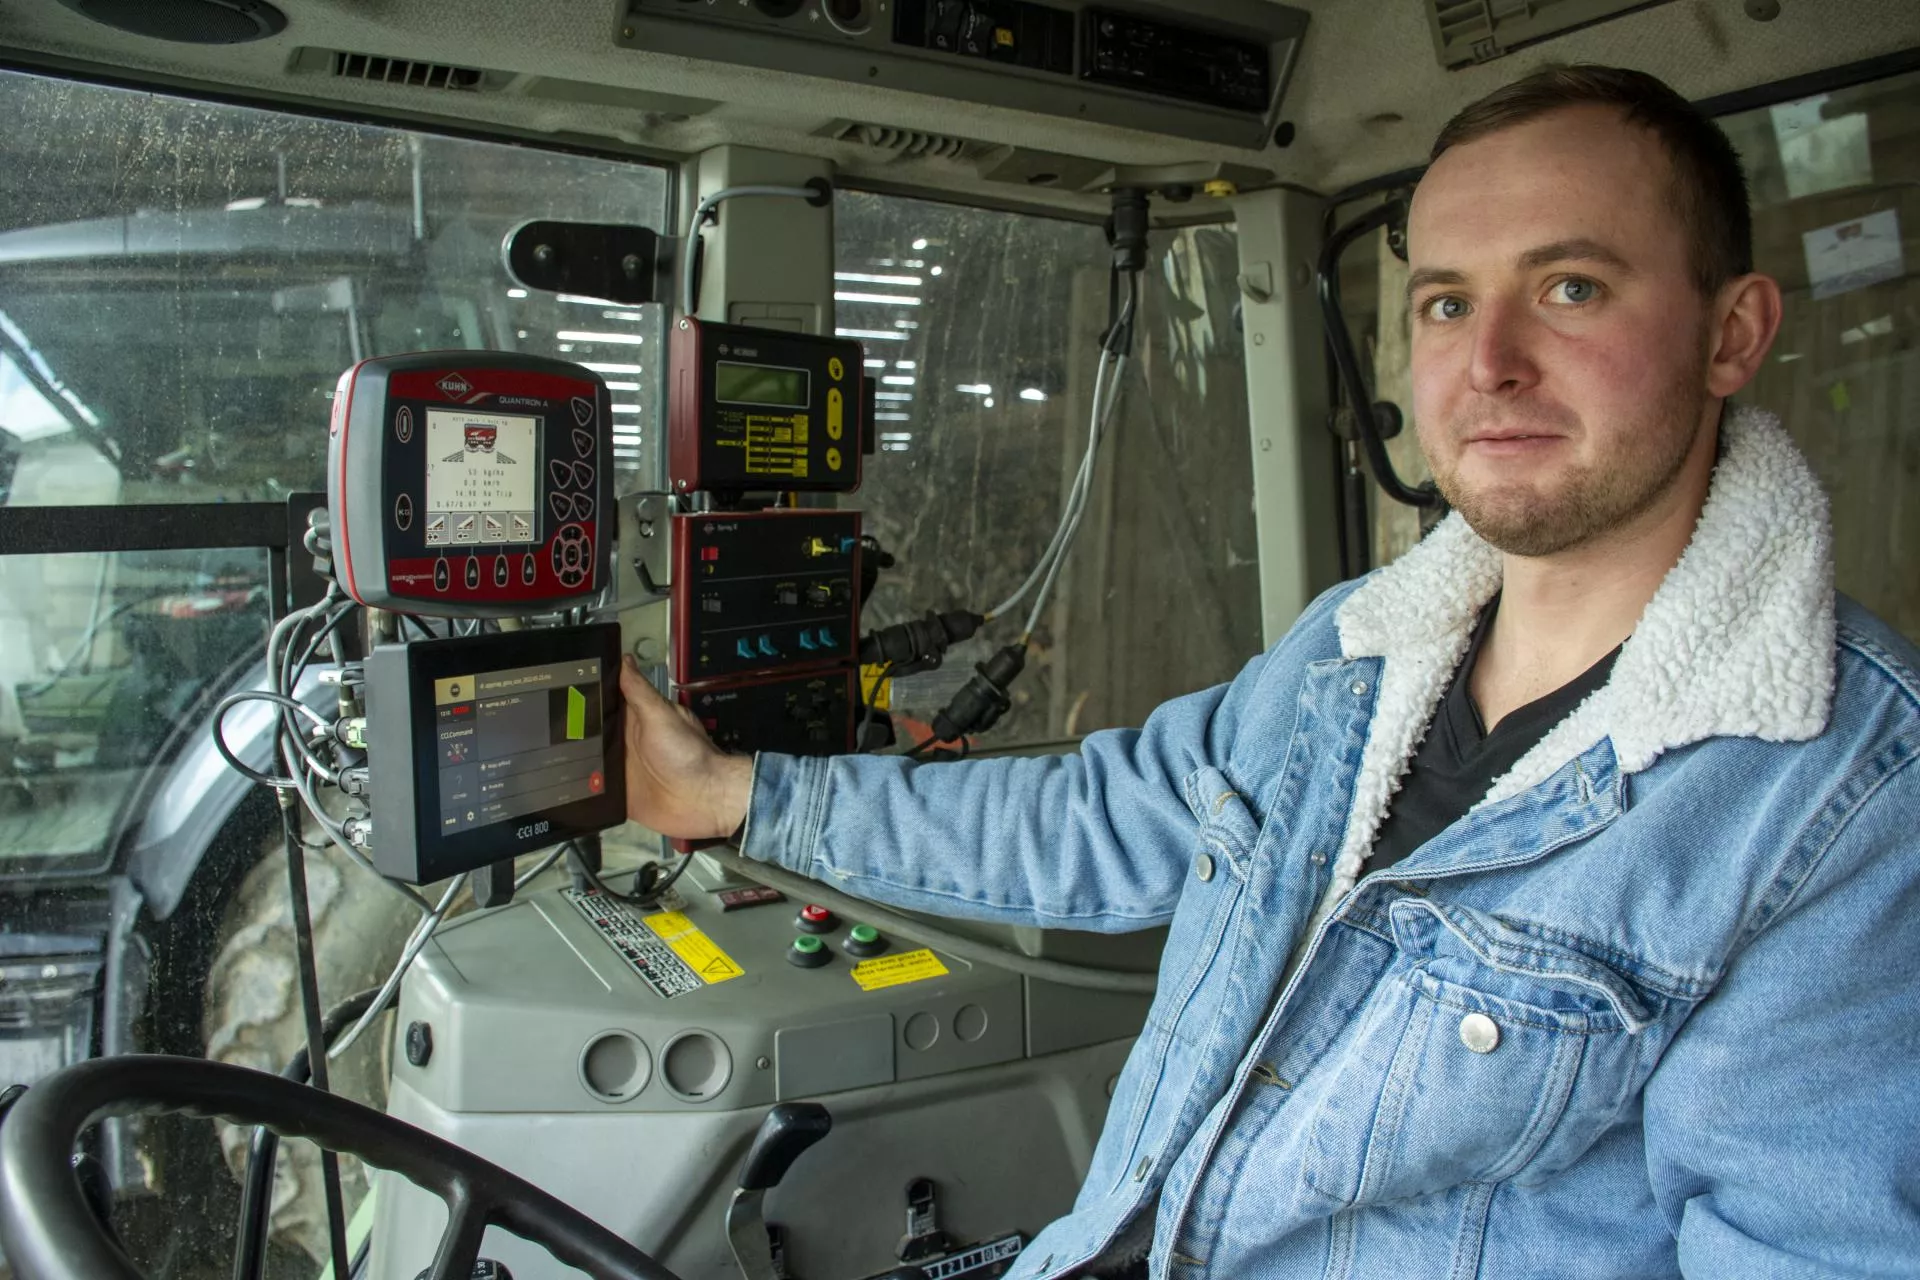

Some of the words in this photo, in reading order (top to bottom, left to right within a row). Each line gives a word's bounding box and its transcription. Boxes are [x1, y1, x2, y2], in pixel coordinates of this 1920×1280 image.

[441, 380, 468, 393] KUHN
[499, 396, 540, 408] QUANTRON
[542, 400, 549, 408] A
[517, 826, 532, 840] CCI
[535, 821, 549, 834] 800
